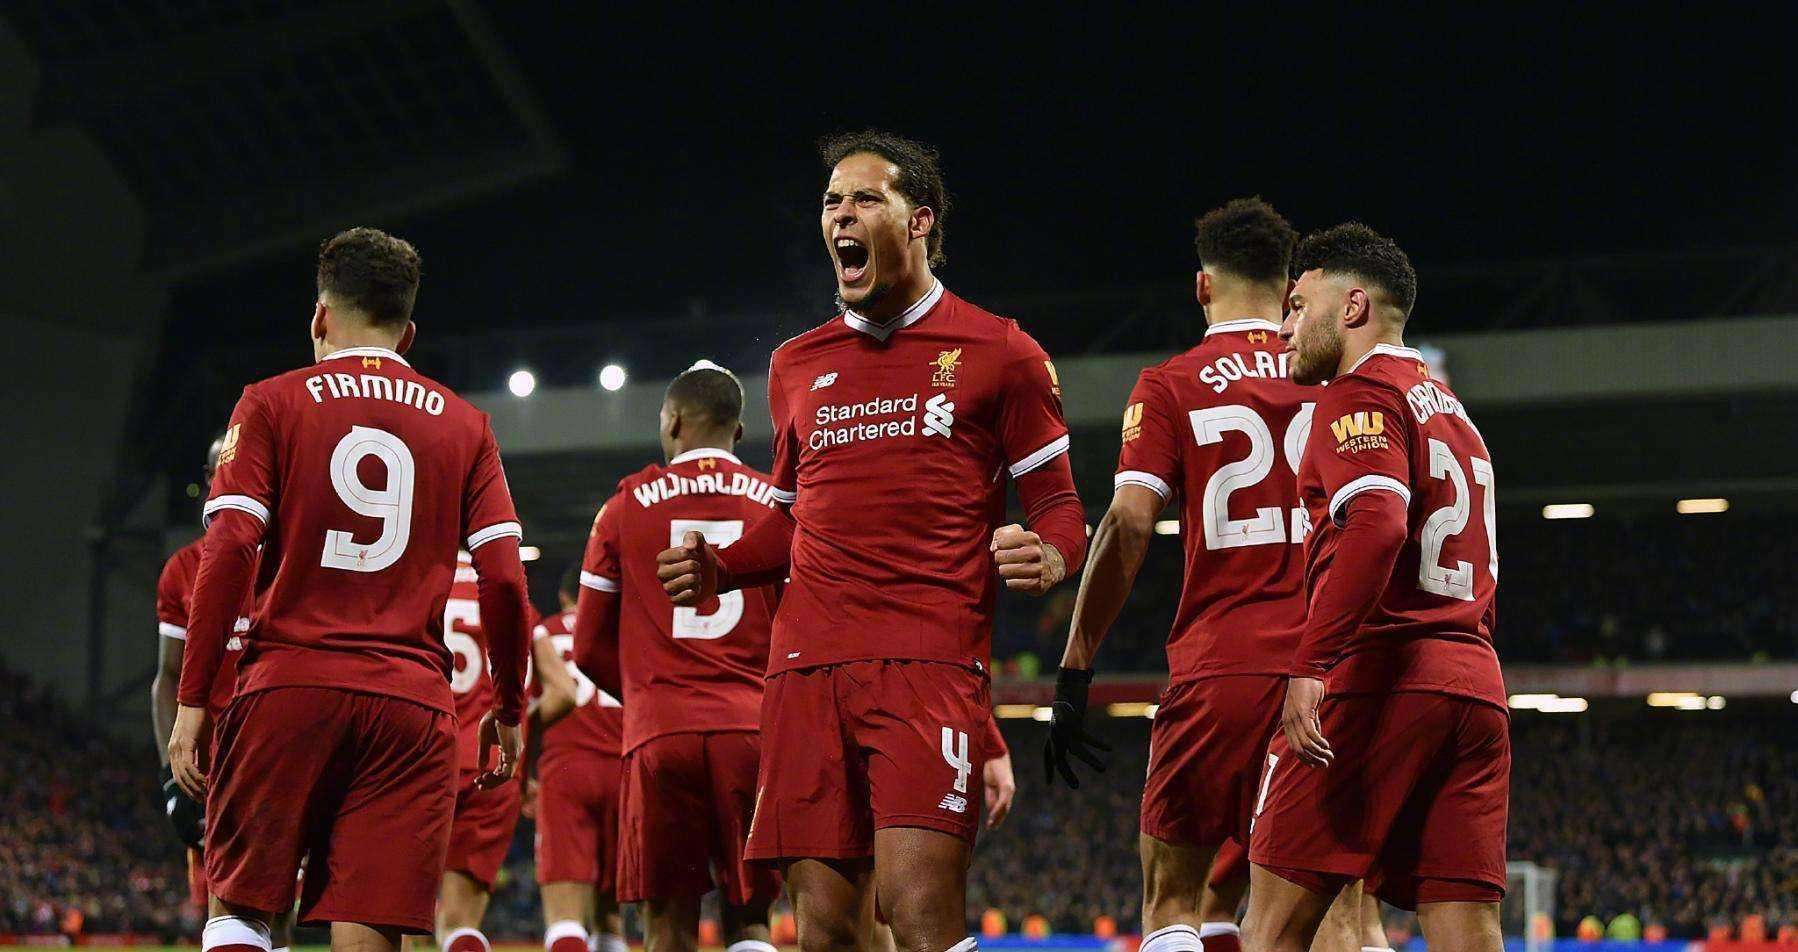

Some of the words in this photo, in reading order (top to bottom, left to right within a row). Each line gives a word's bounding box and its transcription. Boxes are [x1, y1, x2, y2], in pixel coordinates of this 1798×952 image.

[305, 373, 445, 416] FIRMINO
[816, 393, 918, 425] Standard
[809, 415, 916, 450] Chartered
[1330, 411, 1385, 444] WU
[1336, 435, 1387, 454] WESTERN
[1351, 442, 1389, 454] UNION
[320, 424, 415, 573] 9
[941, 726, 972, 793] 4
